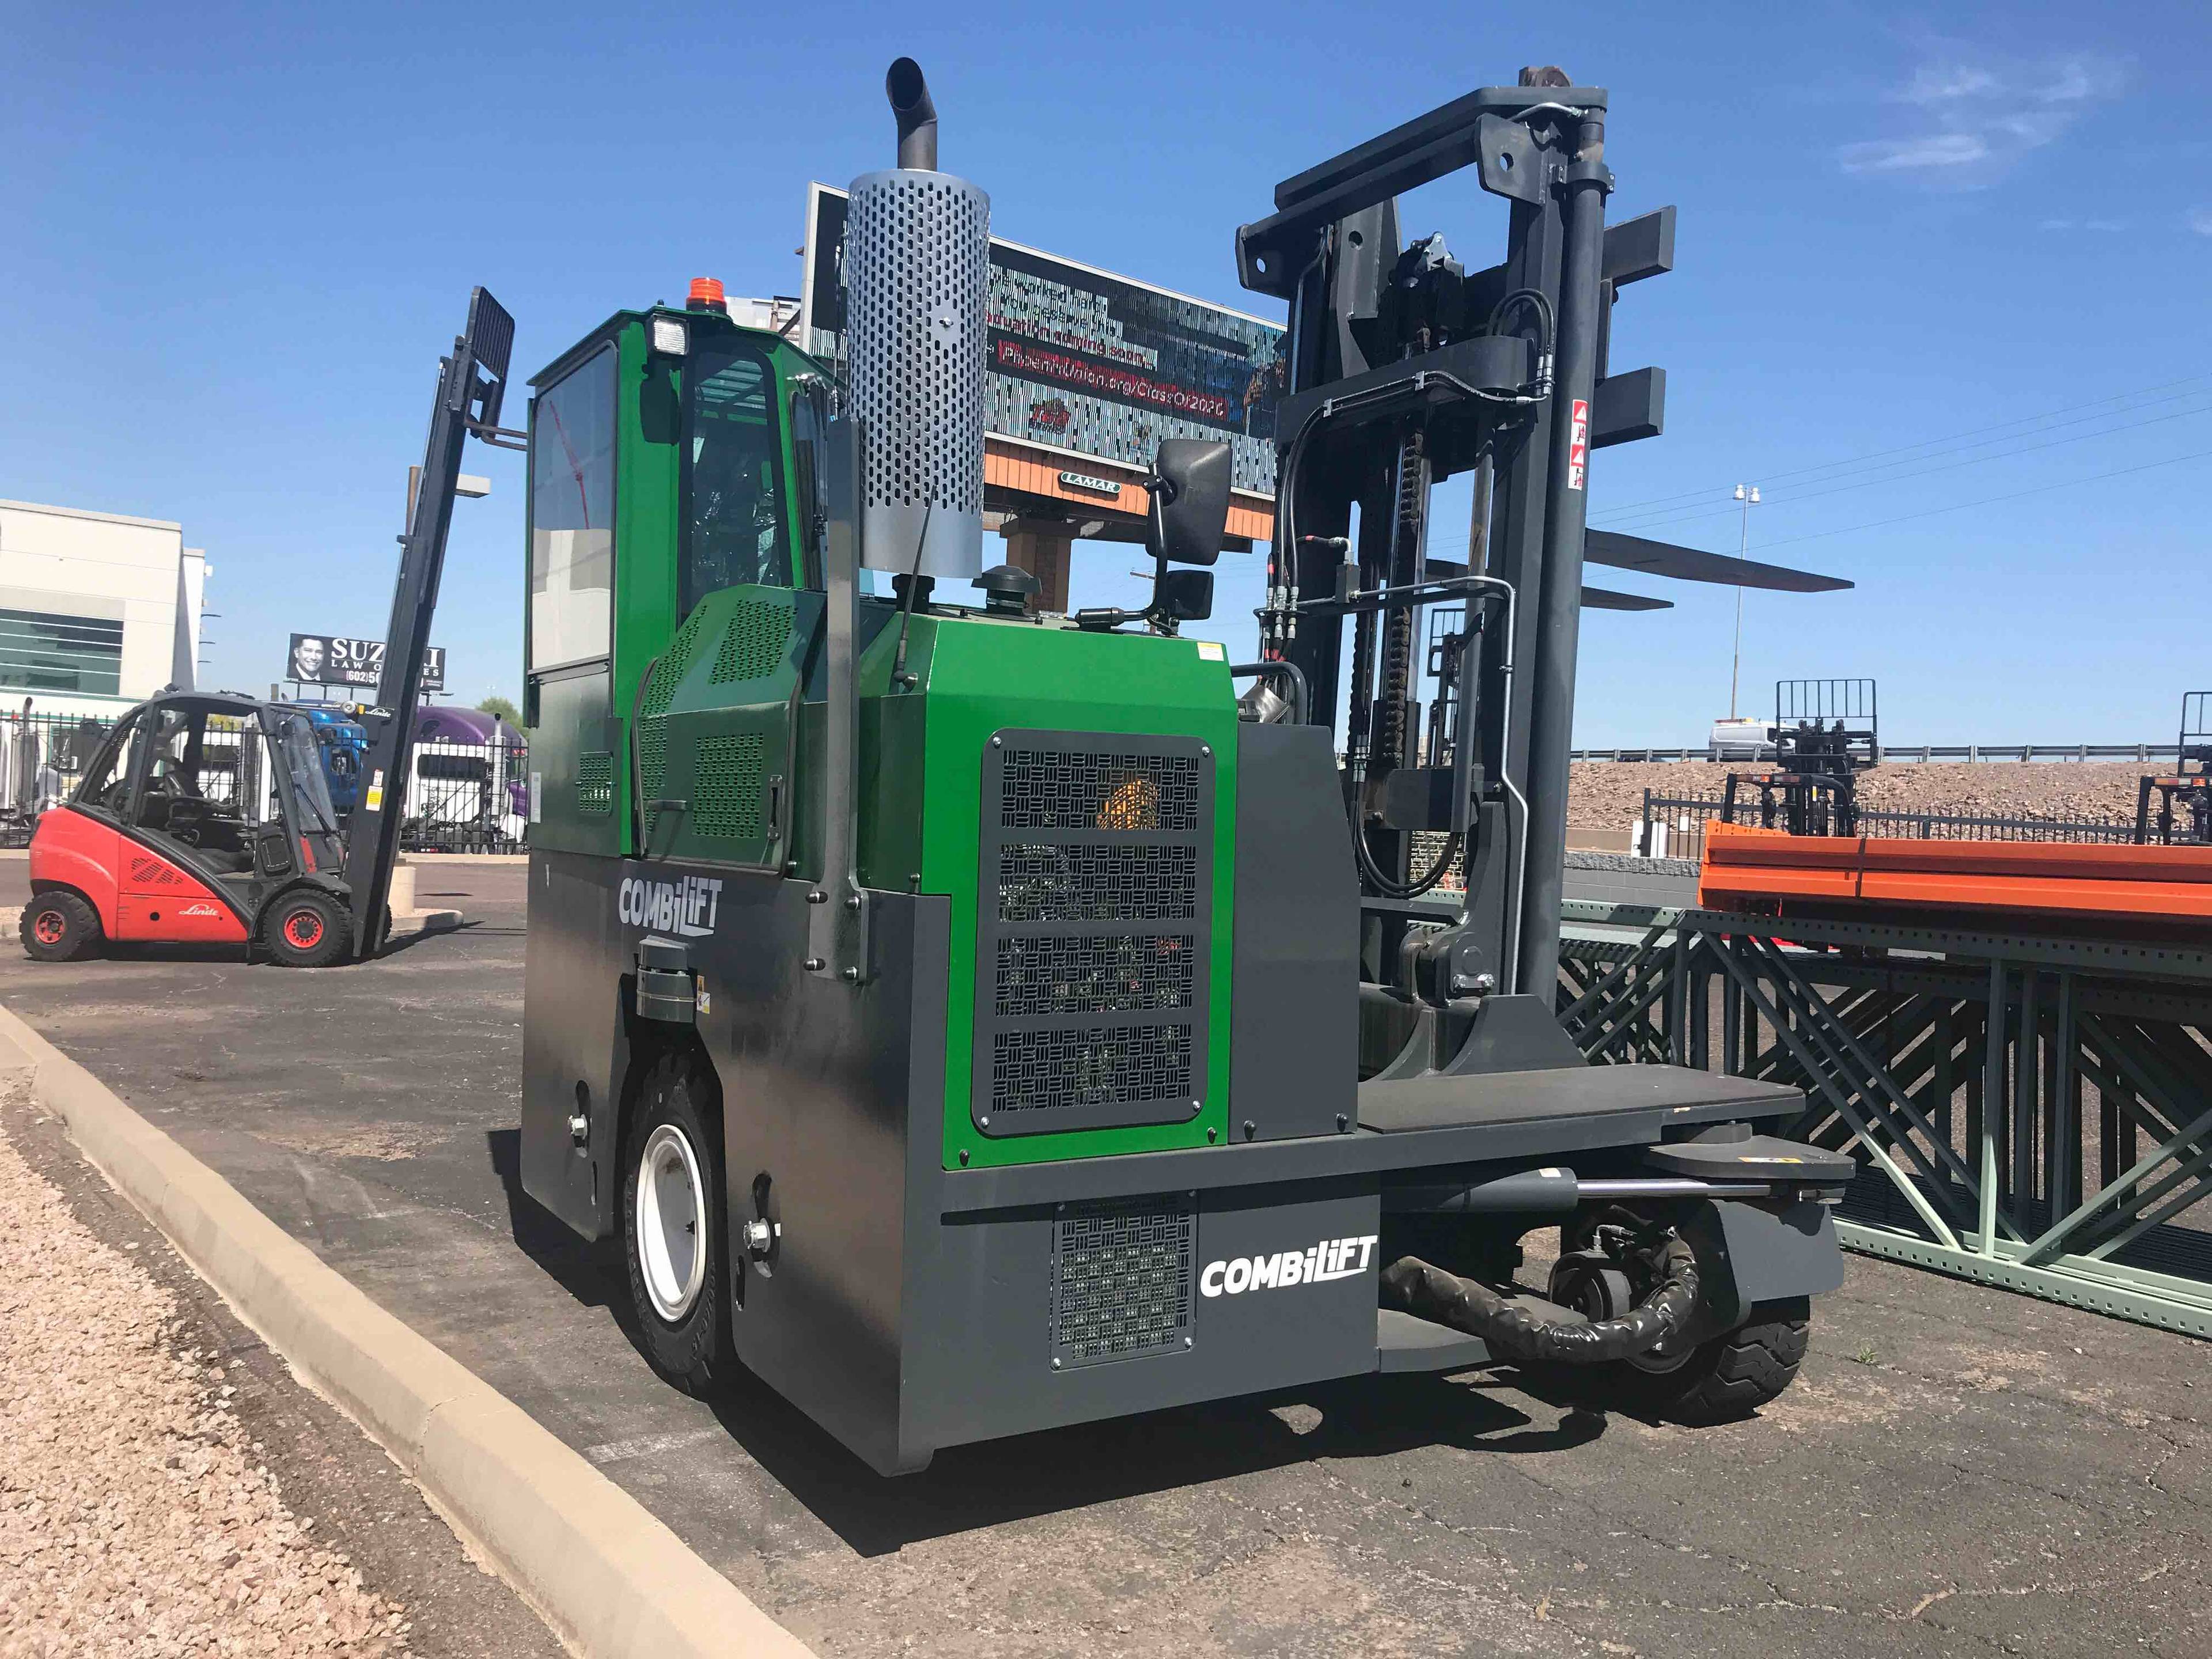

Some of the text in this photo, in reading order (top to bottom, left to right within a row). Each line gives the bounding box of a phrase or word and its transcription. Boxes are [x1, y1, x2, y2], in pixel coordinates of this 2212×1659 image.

[1066, 474, 1116, 491] LAMAR
[331, 660, 363, 669] LAW
[365, 708, 392, 718] Linde
[178, 904, 219, 916] Linde
